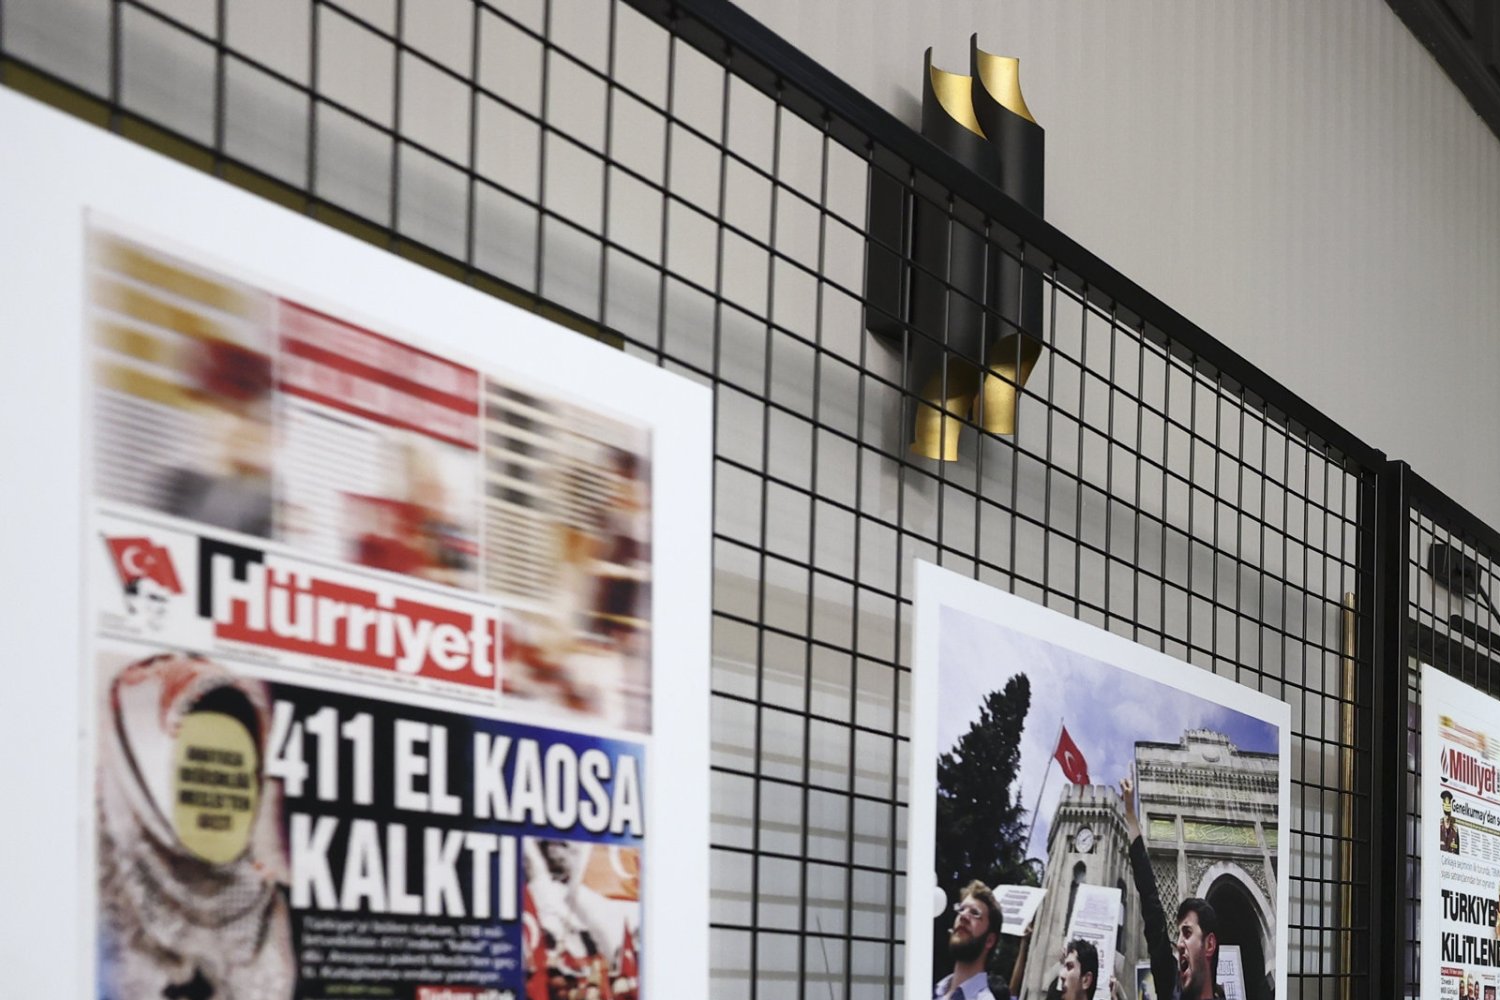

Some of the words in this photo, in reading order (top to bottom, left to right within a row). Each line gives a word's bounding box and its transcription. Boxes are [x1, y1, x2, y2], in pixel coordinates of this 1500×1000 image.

[212, 552, 496, 677] Hürriyet
[265, 699, 374, 805] 411
[393, 716, 462, 815] EL
[472, 731, 644, 838] KAOSA
[1449, 748, 1497, 796] Milliyet
[1451, 799, 1496, 825] Genelkurmay'dan
[289, 813, 518, 921] KALKTI
[1441, 888, 1500, 928] TÜRKİYE
